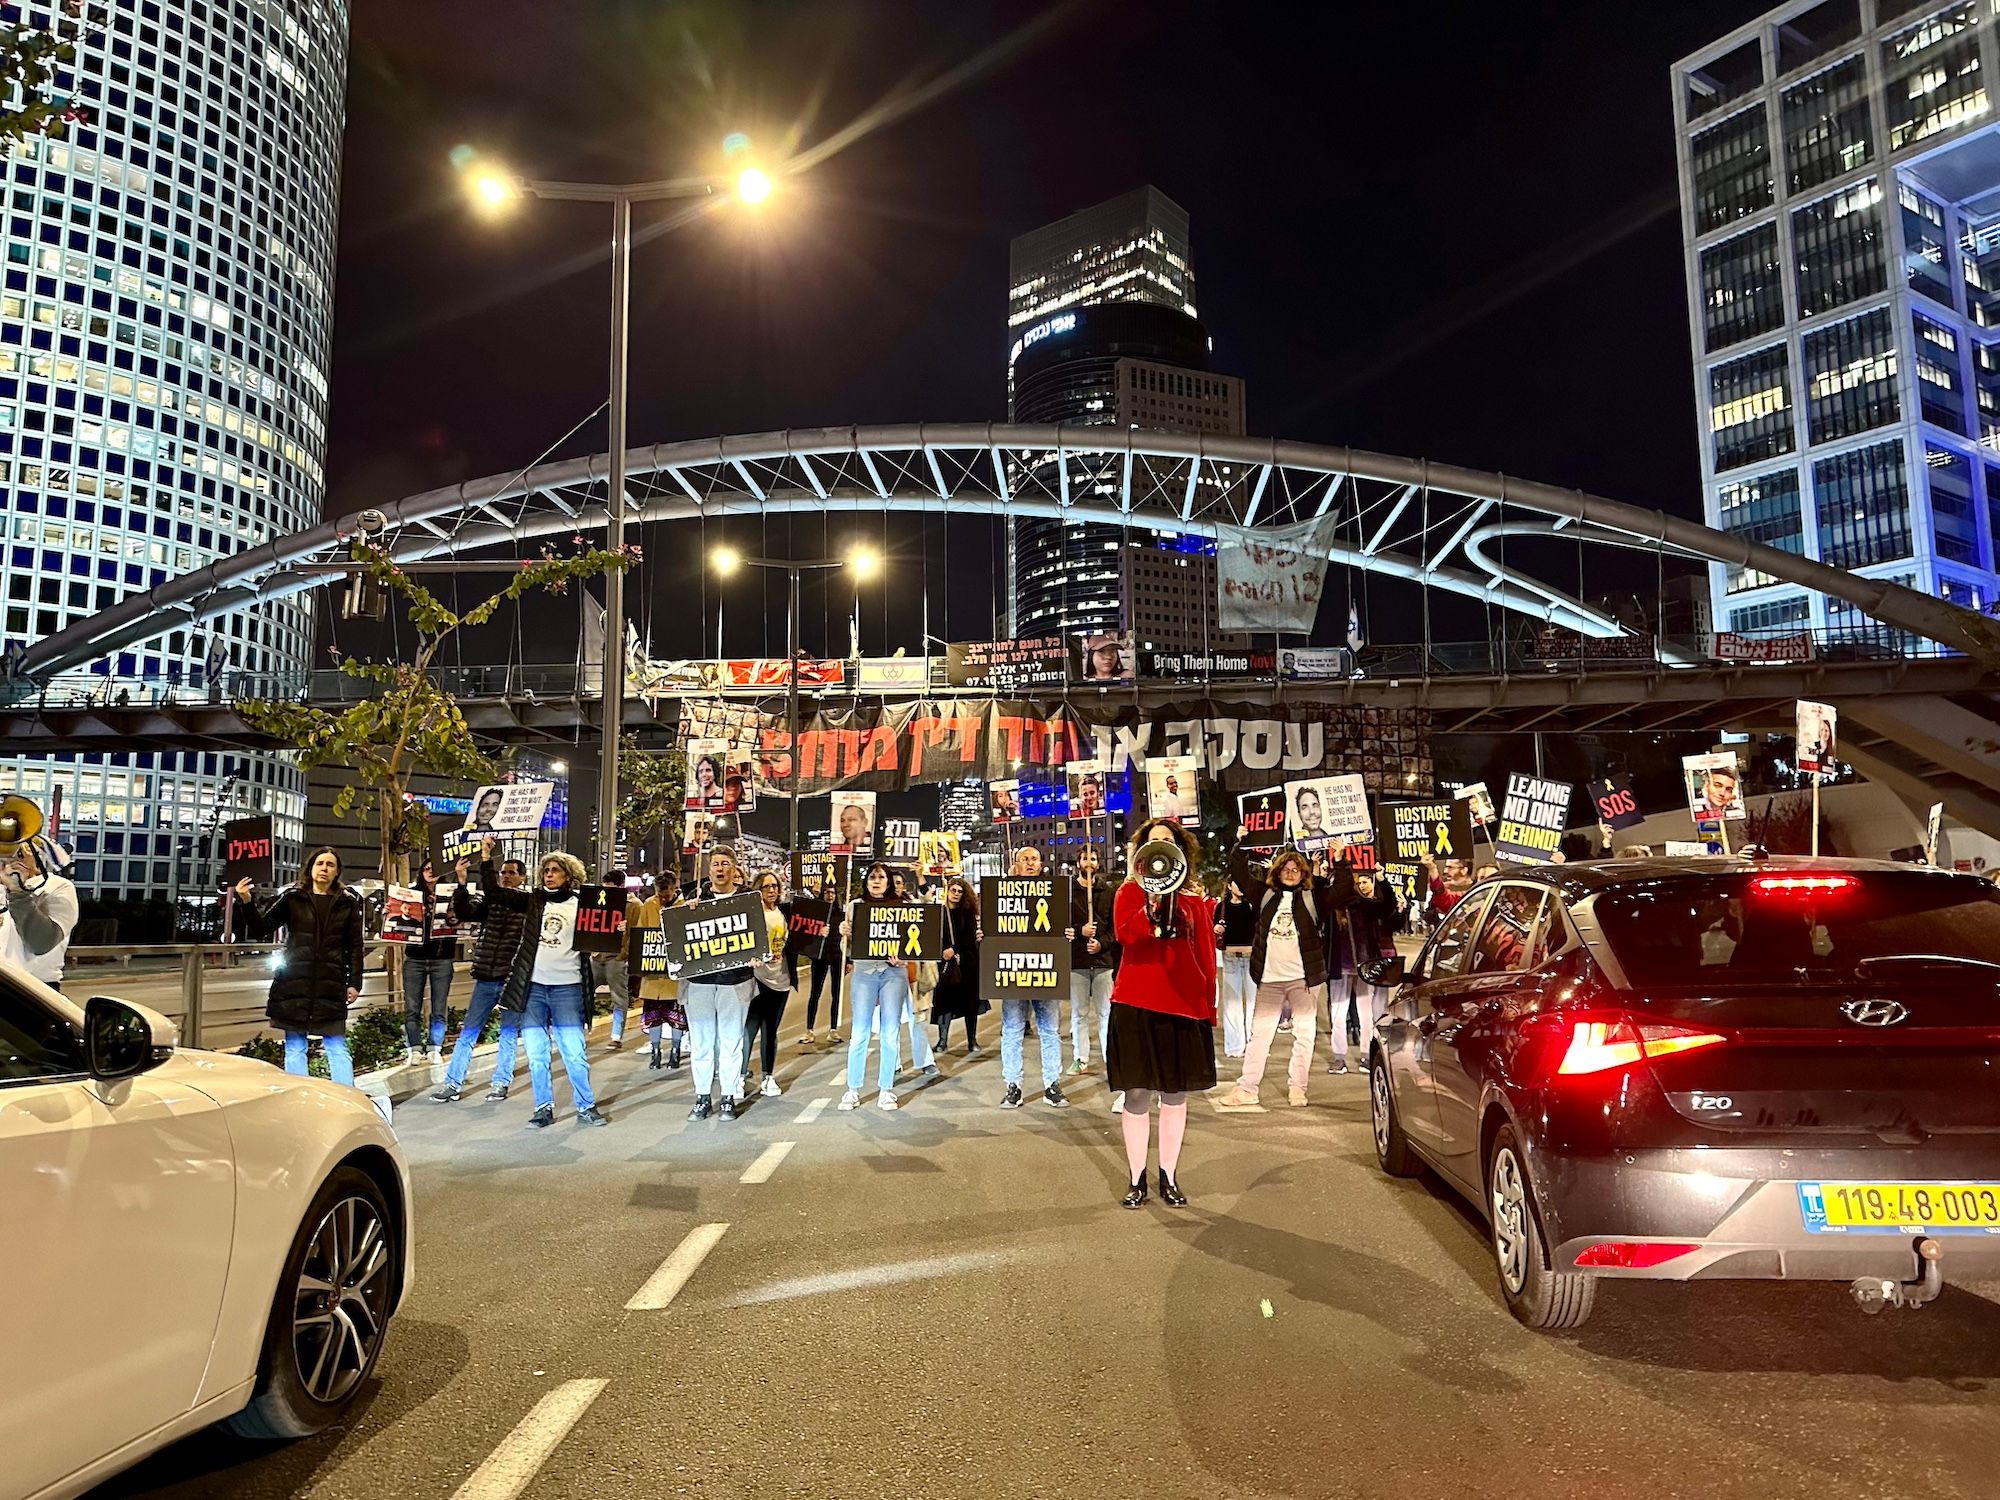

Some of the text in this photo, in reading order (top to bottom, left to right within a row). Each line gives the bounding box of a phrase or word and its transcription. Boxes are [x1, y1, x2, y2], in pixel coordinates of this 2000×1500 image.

[1045, 637, 1061, 647] כל
[1010, 651, 1029, 662] לנו
[1719, 644, 1806, 659] אתה אשם
[988, 661, 1043, 676] לירי אלבג
[1154, 654, 1181, 672] Bring
[1183, 654, 1214, 670] Them
[1216, 654, 1248, 670] Home
[1032, 671, 1067, 683] חטופה
[908, 716, 982, 777] דין
[1091, 722, 1153, 773] או
[1164, 718, 1324, 782] עסקה
[1324, 783, 1353, 795] HE HAS NO
[1508, 774, 1571, 806] LEAVING
[1325, 796, 1340, 805] TIME
[1341, 795, 1349, 804] TO
[1598, 789, 1636, 819] SOS
[1329, 805, 1356, 817] BRING HIM
[1395, 805, 1452, 822] HOSTAGE
[1503, 795, 1567, 831] NO ONE
[884, 819, 902, 837] לא
[1245, 810, 1285, 832] HELP
[1330, 815, 1364, 827] HOME ALIVE!
[1396, 823, 1430, 839] DEAL
[1498, 820, 1563, 853] BEHIND!
[228, 838, 270, 861] הצילו
[441, 840, 482, 864] כשיו!
[1398, 840, 1431, 858] NOW
[802, 853, 836, 865] HOSTAGE
[802, 864, 823, 875] DEAL
[1385, 863, 1418, 875] HOSTAGE
[802, 876, 823, 888] NOW
[998, 881, 1053, 897] HOSTAGE
[869, 907, 925, 922] HOSTAGE
[998, 898, 1030, 914] DEAL
[576, 908, 623, 934] HELP
[684, 913, 748, 941] עסקה
[788, 915, 826, 937] הצילו
[998, 915, 1030, 933] NOW
[643, 931, 664, 943] HOS
[869, 923, 901, 939] DEAL
[642, 943, 668, 957] DEAL
[683, 931, 756, 962] עכשיו!
[868, 940, 901, 957] NOW
[641, 958, 667, 971] NOW
[998, 952, 1054, 972] עסקה
[995, 970, 1058, 987] עכשיו!
